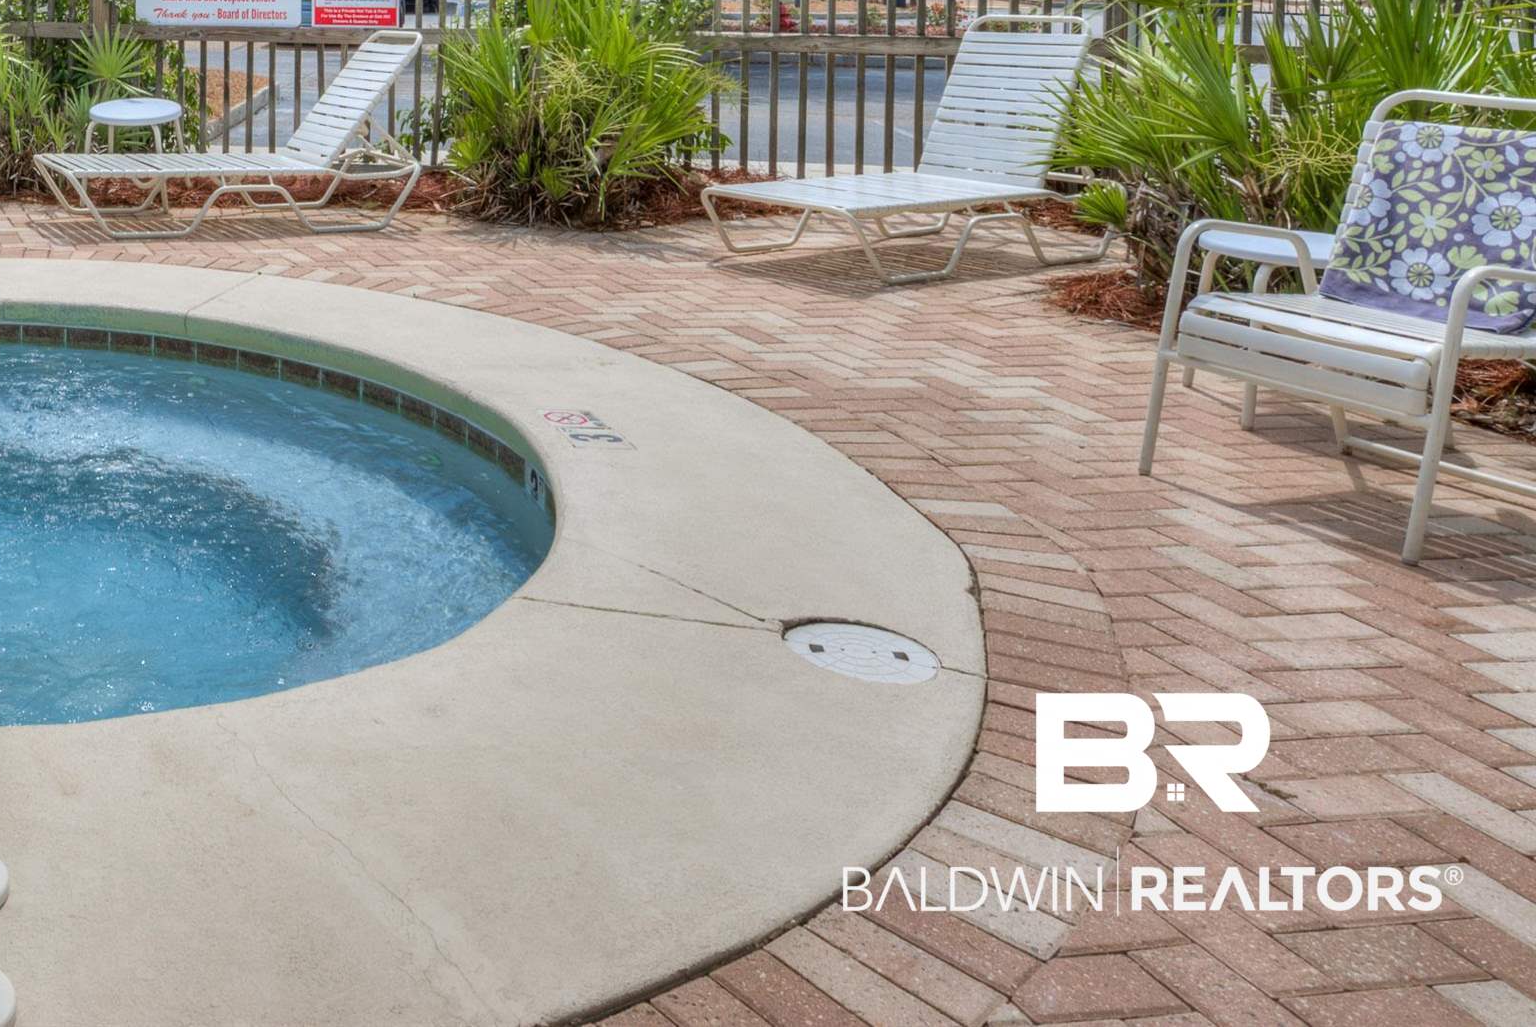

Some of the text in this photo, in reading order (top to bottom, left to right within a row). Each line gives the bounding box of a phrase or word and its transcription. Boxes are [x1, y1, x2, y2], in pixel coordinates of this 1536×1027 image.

[153, 8, 188, 19] Thank
[191, 12, 210, 21] you
[217, 8, 240, 20] Board
[242, 8, 250, 20] of
[252, 8, 288, 20] Directors
